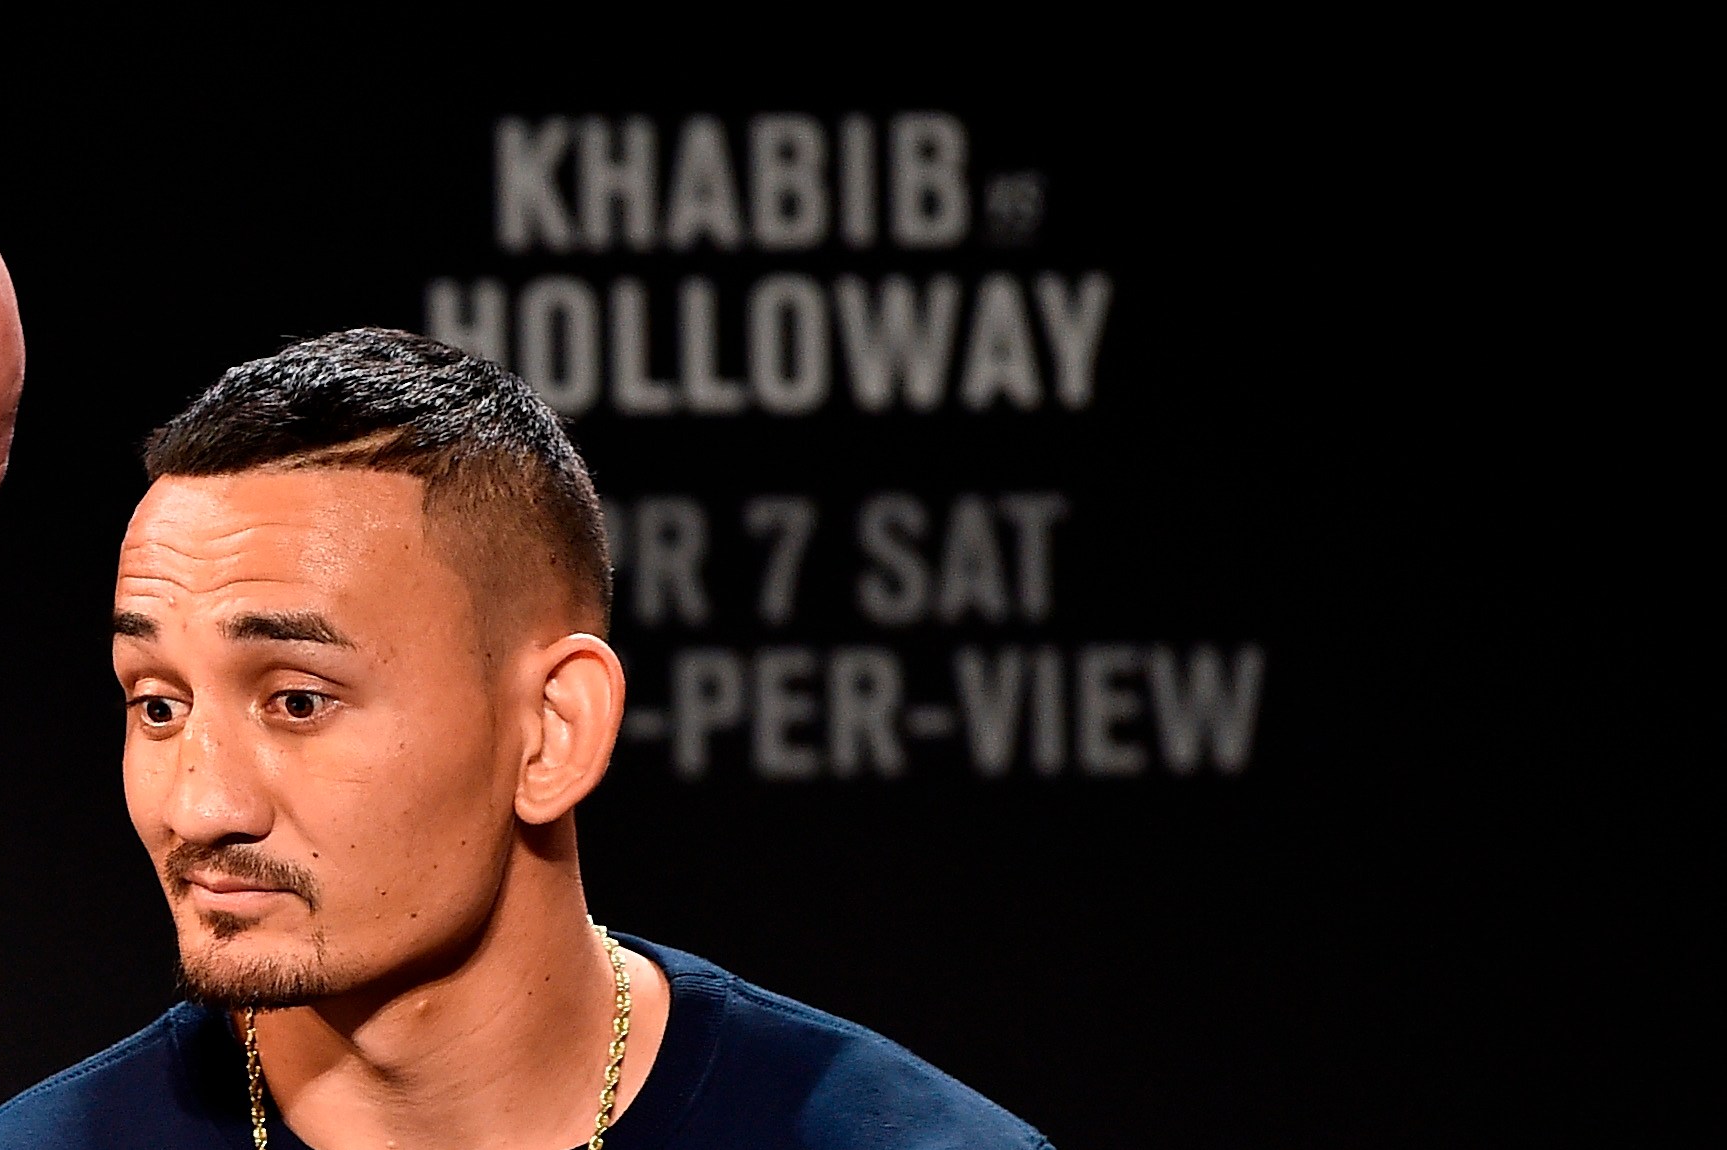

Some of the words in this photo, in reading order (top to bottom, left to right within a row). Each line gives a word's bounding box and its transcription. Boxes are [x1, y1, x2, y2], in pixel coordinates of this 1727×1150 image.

[491, 110, 974, 256] KHABIB
[424, 270, 1117, 416] HOLLOWAY
[600, 492, 713, 628] R
[740, 492, 823, 628] 7
[852, 490, 1074, 629] SAT
